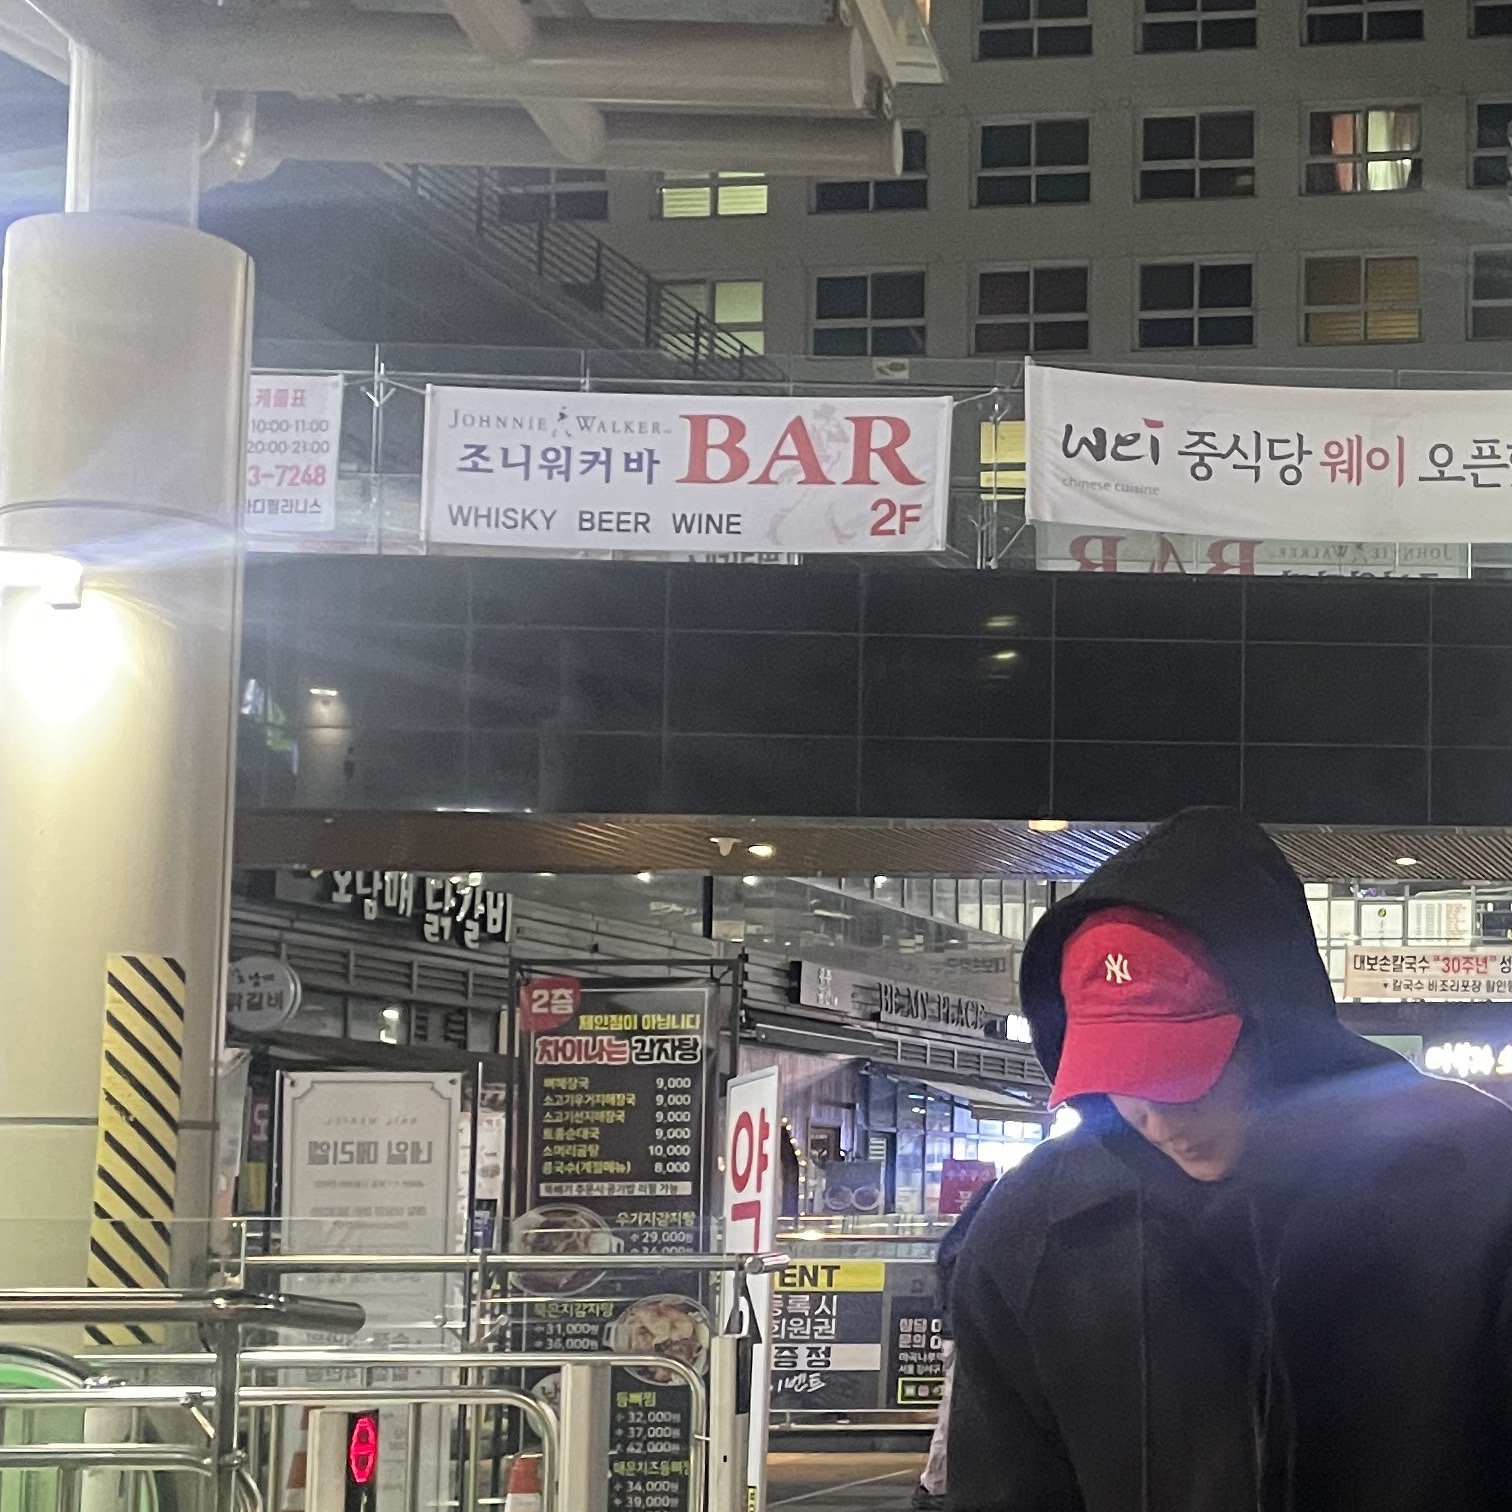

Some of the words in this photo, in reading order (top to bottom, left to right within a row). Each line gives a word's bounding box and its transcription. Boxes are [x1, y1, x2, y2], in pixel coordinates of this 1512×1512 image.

[448, 408, 547, 431] JOHNNIE
[576, 414, 664, 435] WALKER
[675, 413, 926, 486] BAR
[1061, 417, 1165, 466] wei
[1177, 430, 1313, 487] 중식당
[1319, 433, 1405, 488] 웨이
[1113, 481, 1161, 496] cuisine
[447, 504, 557, 531] WHISKY
[578, 509, 651, 534] BEER
[672, 513, 742, 535] WINE
[869, 498, 922, 536] 2F
[1353, 954, 1431, 975] 대보손칼국수
[531, 988, 575, 1014] 2층
[1391, 979, 1425, 994] 칼국수
[1427, 979, 1483, 994] 비조리포장
[631, 1035, 702, 1065] 감자탕
